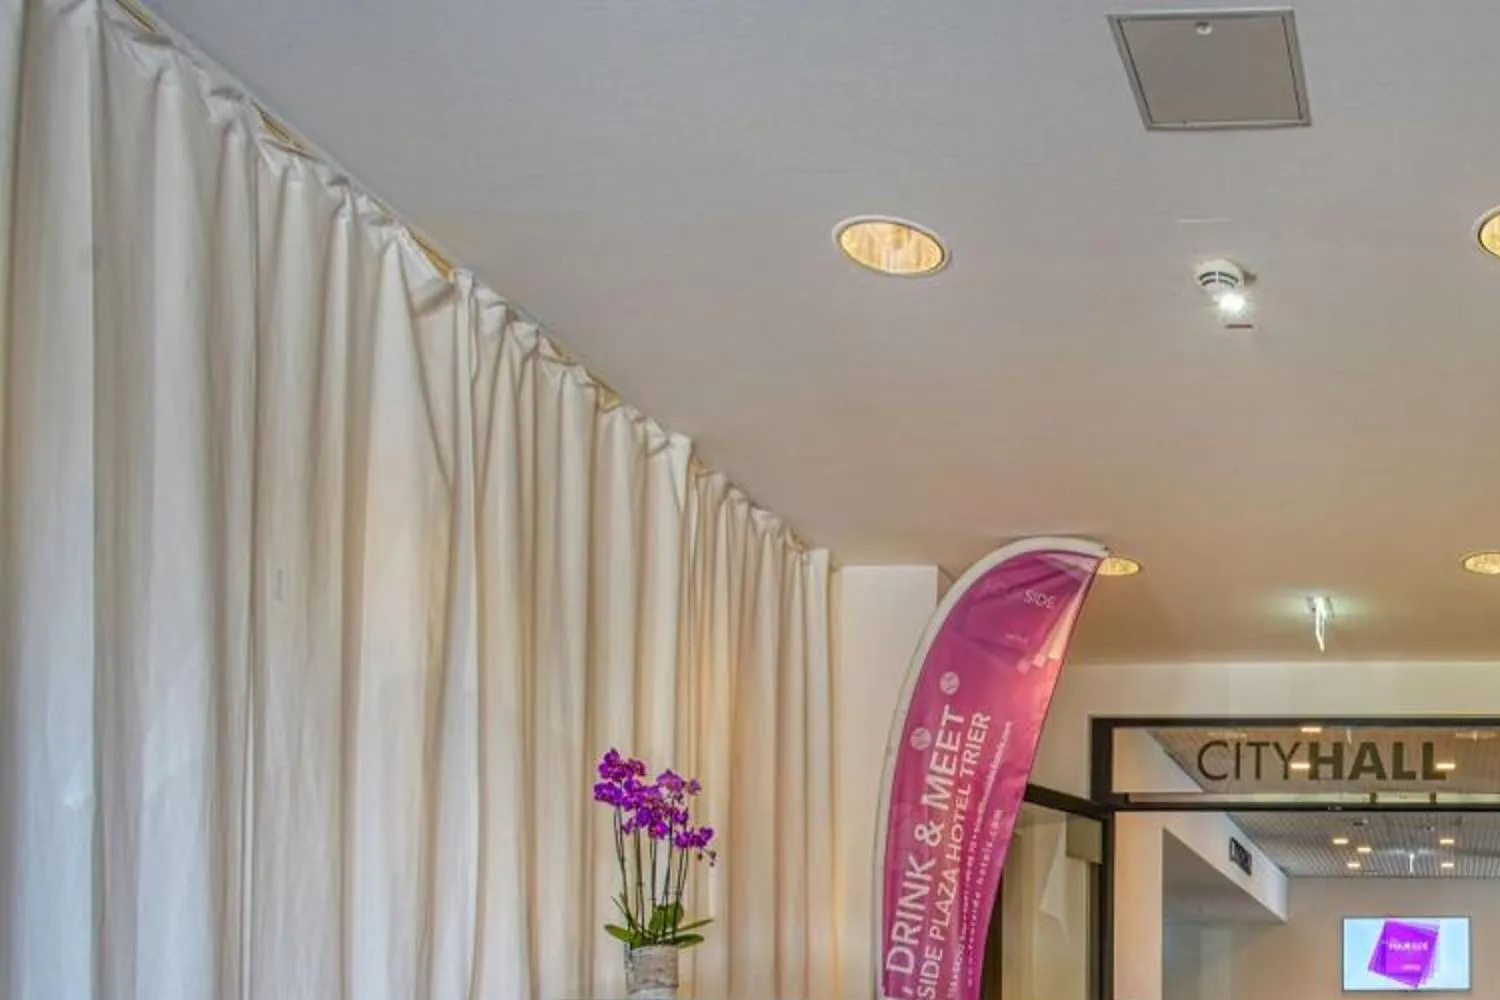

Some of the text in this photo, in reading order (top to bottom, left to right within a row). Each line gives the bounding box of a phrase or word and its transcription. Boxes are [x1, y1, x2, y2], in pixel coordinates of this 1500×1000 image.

[920, 704, 965, 811] MEET
[1197, 740, 1447, 781] CITYHALL
[914, 819, 944, 847] &
[929, 867, 961, 941] PLAZA
[946, 783, 971, 863] HOTEL
[960, 712, 992, 777] TRIER
[886, 854, 936, 974] DRINK
